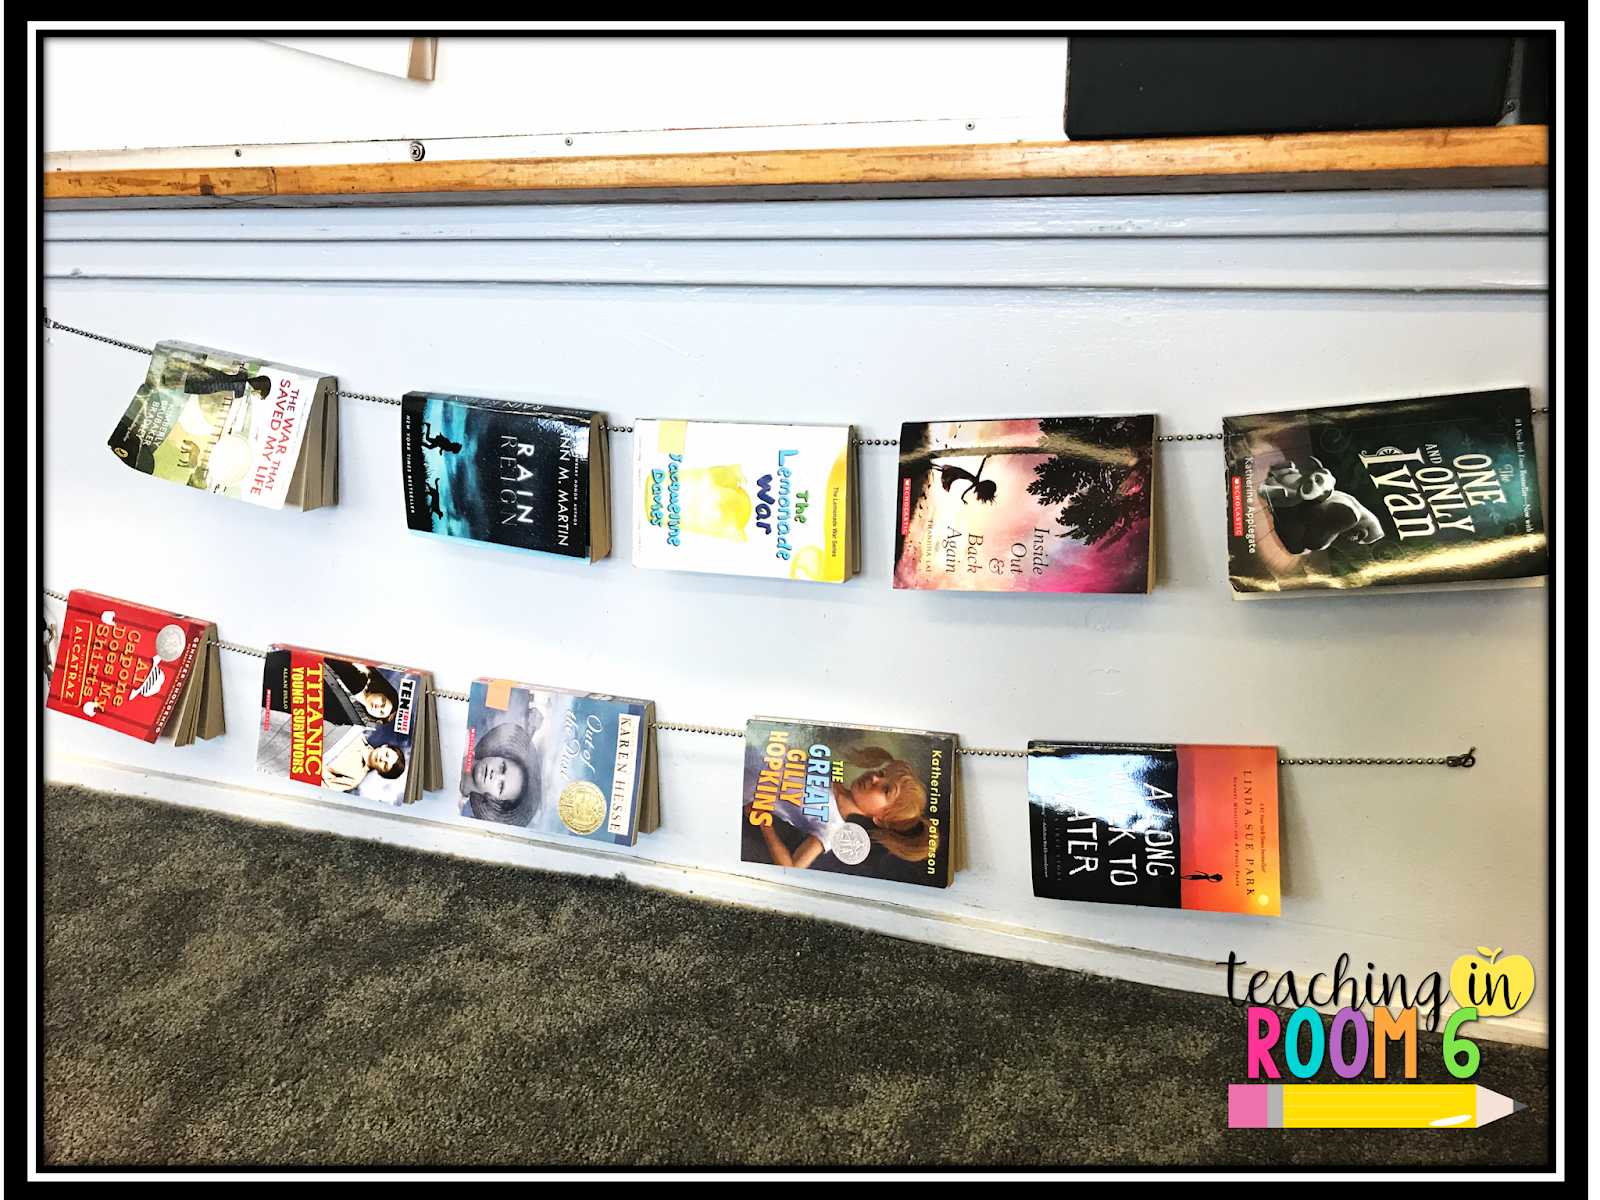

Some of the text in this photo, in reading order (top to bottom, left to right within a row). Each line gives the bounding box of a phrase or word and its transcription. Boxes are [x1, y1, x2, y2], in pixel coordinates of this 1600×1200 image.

[135, 402, 160, 440] BRADLEY
[142, 400, 168, 446] BRUBAKER
[153, 404, 174, 448] KIMBERLY
[287, 389, 299, 412] THE
[1514, 418, 1523, 427] #1
[250, 379, 290, 496] SAVED MY LIFE
[275, 418, 295, 455] WAR
[1424, 443, 1443, 465] AND
[1515, 429, 1523, 440] New
[1516, 441, 1525, 453] York
[264, 460, 280, 492] THAT
[407, 475, 415, 514] BESTSELLER
[500, 435, 518, 526] REIGN
[517, 443, 535, 523] RAIN
[558, 428, 571, 546] ANN M. MARTIN
[651, 468, 665, 528] Davies
[667, 453, 683, 546] Jacqueline
[1358, 446, 1438, 541] Ivan
[1415, 466, 1476, 533] ONLY
[1452, 454, 1507, 506] ONE
[1498, 464, 1514, 483] The
[756, 474, 776, 535] War
[776, 449, 799, 560] Lemonade
[794, 490, 809, 523] The
[1234, 485, 1242, 536] SCHOLASTIC
[1244, 457, 1256, 554] Katherine Applegate
[1525, 519, 1534, 532] with
[945, 526, 962, 573] Again
[967, 532, 983, 574] Back
[989, 557, 1004, 575] &
[1010, 542, 1027, 575] Out
[1032, 527, 1050, 575] Inside
[65, 626, 83, 698] ALCATRAZ
[82, 624, 109, 698] Shirts
[95, 624, 126, 712] Does My
[112, 630, 142, 707] Capone
[132, 658, 149, 685] Al
[155, 637, 199, 733] GENNIFER CHOLDENKO
[291, 667, 305, 774] YOUNG SURVIVORS
[305, 662, 323, 776] TITANIC
[400, 682, 413, 732] TEN TRUE
[467, 734, 475, 772] SCHOLASTIC
[560, 709, 581, 781] the Dust
[580, 715, 603, 774] Out of
[617, 717, 632, 773] KAREN
[832, 761, 843, 783] THE
[610, 781, 626, 832] HESSE
[749, 731, 789, 827] HOPKINS
[778, 748, 807, 807] GILLY
[803, 744, 831, 822] GREAT
[927, 750, 942, 875] Katherine Paterson
[1067, 777, 1099, 876] WATER
[1108, 770, 1138, 886] WALK TO
[1143, 782, 1176, 877] A LONG
[1243, 770, 1256, 896] LINDA SUE PARK
